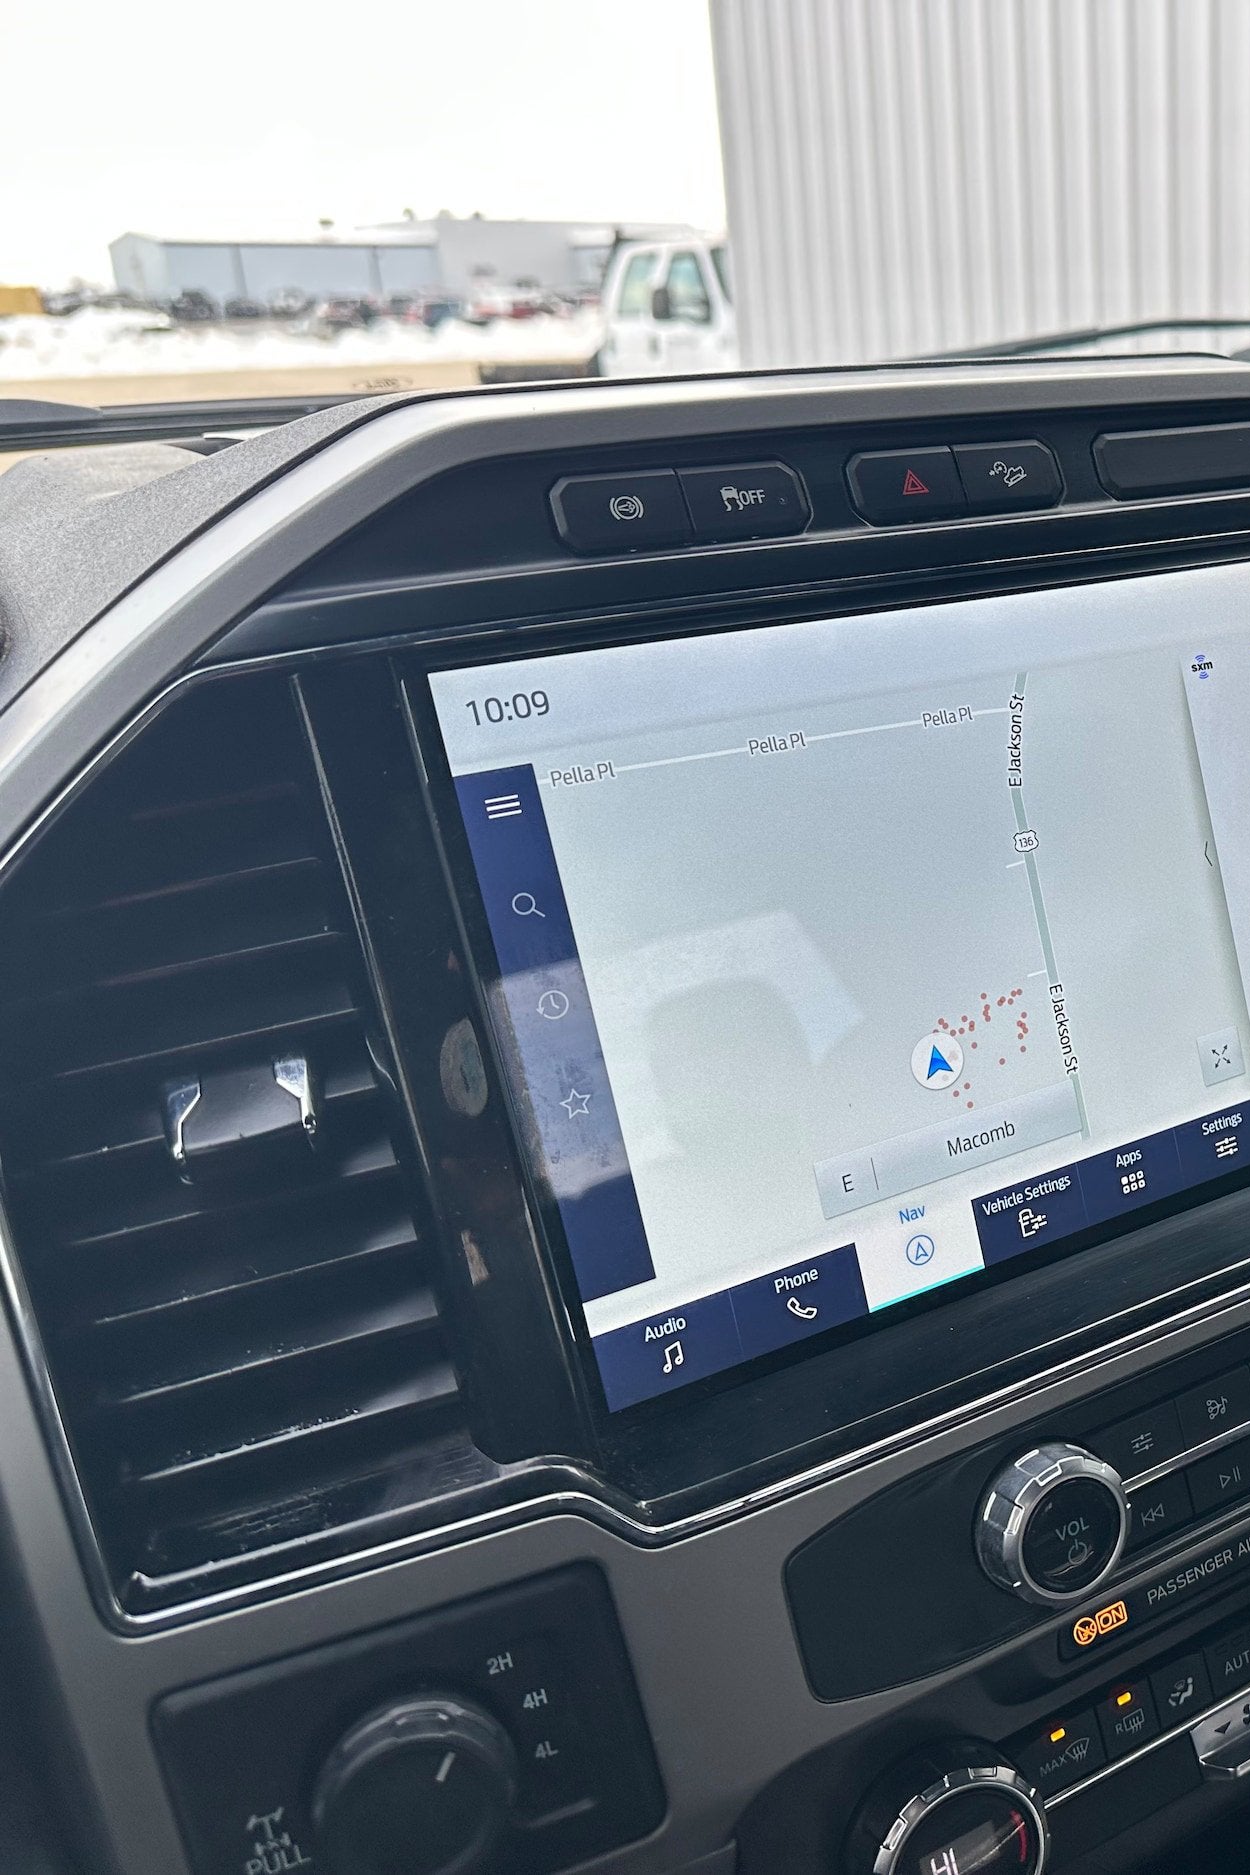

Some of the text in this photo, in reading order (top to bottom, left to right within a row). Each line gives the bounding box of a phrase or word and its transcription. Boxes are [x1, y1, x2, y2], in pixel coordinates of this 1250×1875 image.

[739, 489, 765, 507] OFF
[1191, 660, 1213, 673] sxm
[465, 690, 551, 726] 10:09
[922, 707, 973, 728] Pella Pl
[748, 731, 807, 756] Pella Pl
[1008, 694, 1024, 787] E Jackson St
[550, 761, 616, 788] Pella Pl
[1019, 837, 1034, 848] 136
[1050, 984, 1078, 1074] E Jackson St
[1202, 1112, 1243, 1136] Settings
[947, 1121, 1016, 1157] Macomb
[1115, 1148, 1142, 1169] Apps
[842, 1174, 854, 1192] E
[982, 1175, 1071, 1216] Vehicle Settings
[899, 1205, 926, 1225] Nav
[774, 1268, 819, 1293] Phone
[644, 1316, 687, 1342] Audio
[1055, 1517, 1090, 1542] VOL
[1147, 1549, 1233, 1605] PASSENGER
[1100, 1605, 1125, 1628] ON
[487, 1652, 513, 1676] 2H
[522, 1688, 548, 1710] 4H
[1115, 1722, 1125, 1735] R
[534, 1741, 558, 1760] 4L
[1039, 1753, 1069, 1777] MAX
[246, 1845, 311, 1875] PULL
